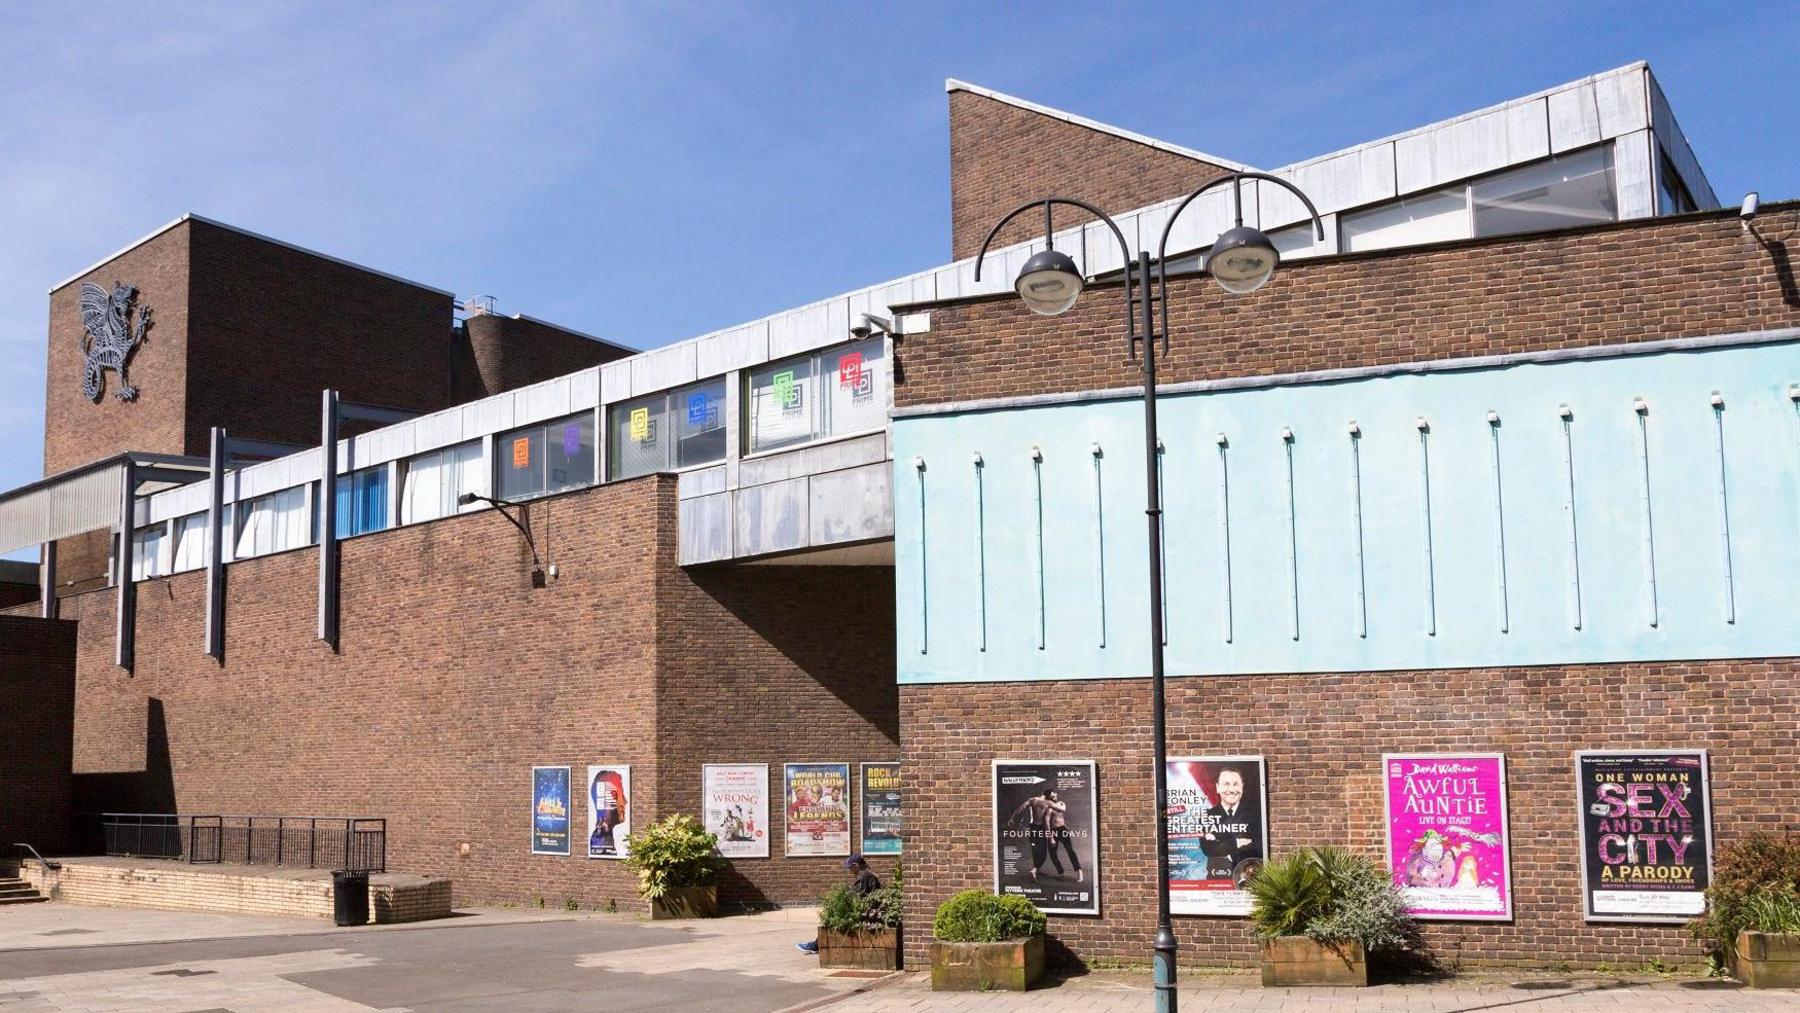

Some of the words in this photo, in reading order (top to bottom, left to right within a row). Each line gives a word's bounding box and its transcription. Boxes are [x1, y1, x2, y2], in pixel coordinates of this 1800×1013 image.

[867, 767, 891, 778] ROCK
[1405, 763, 1437, 775] David
[1438, 763, 1479, 775] Walliams
[791, 778, 845, 787] ROADSHOW
[1595, 773, 1625, 783] ONE
[1632, 772, 1689, 782] WOMAN
[713, 793, 759, 805] WRONG
[1596, 783, 1692, 818] SEX
[792, 811, 843, 819] LEGENDS
[1186, 806, 1208, 817] THE
[1419, 816, 1435, 824] LIVE
[1437, 816, 1446, 824] ON
[1448, 816, 1471, 825] STAGE!
[1598, 819, 1643, 833] AND
[1651, 819, 1693, 833] THE
[1003, 830, 1058, 838] FOURTEEN
[1062, 830, 1088, 838] DAYS
[1598, 833, 1693, 865] CITY
[1601, 866, 1613, 878] A
[1620, 866, 1694, 879] PARODY
